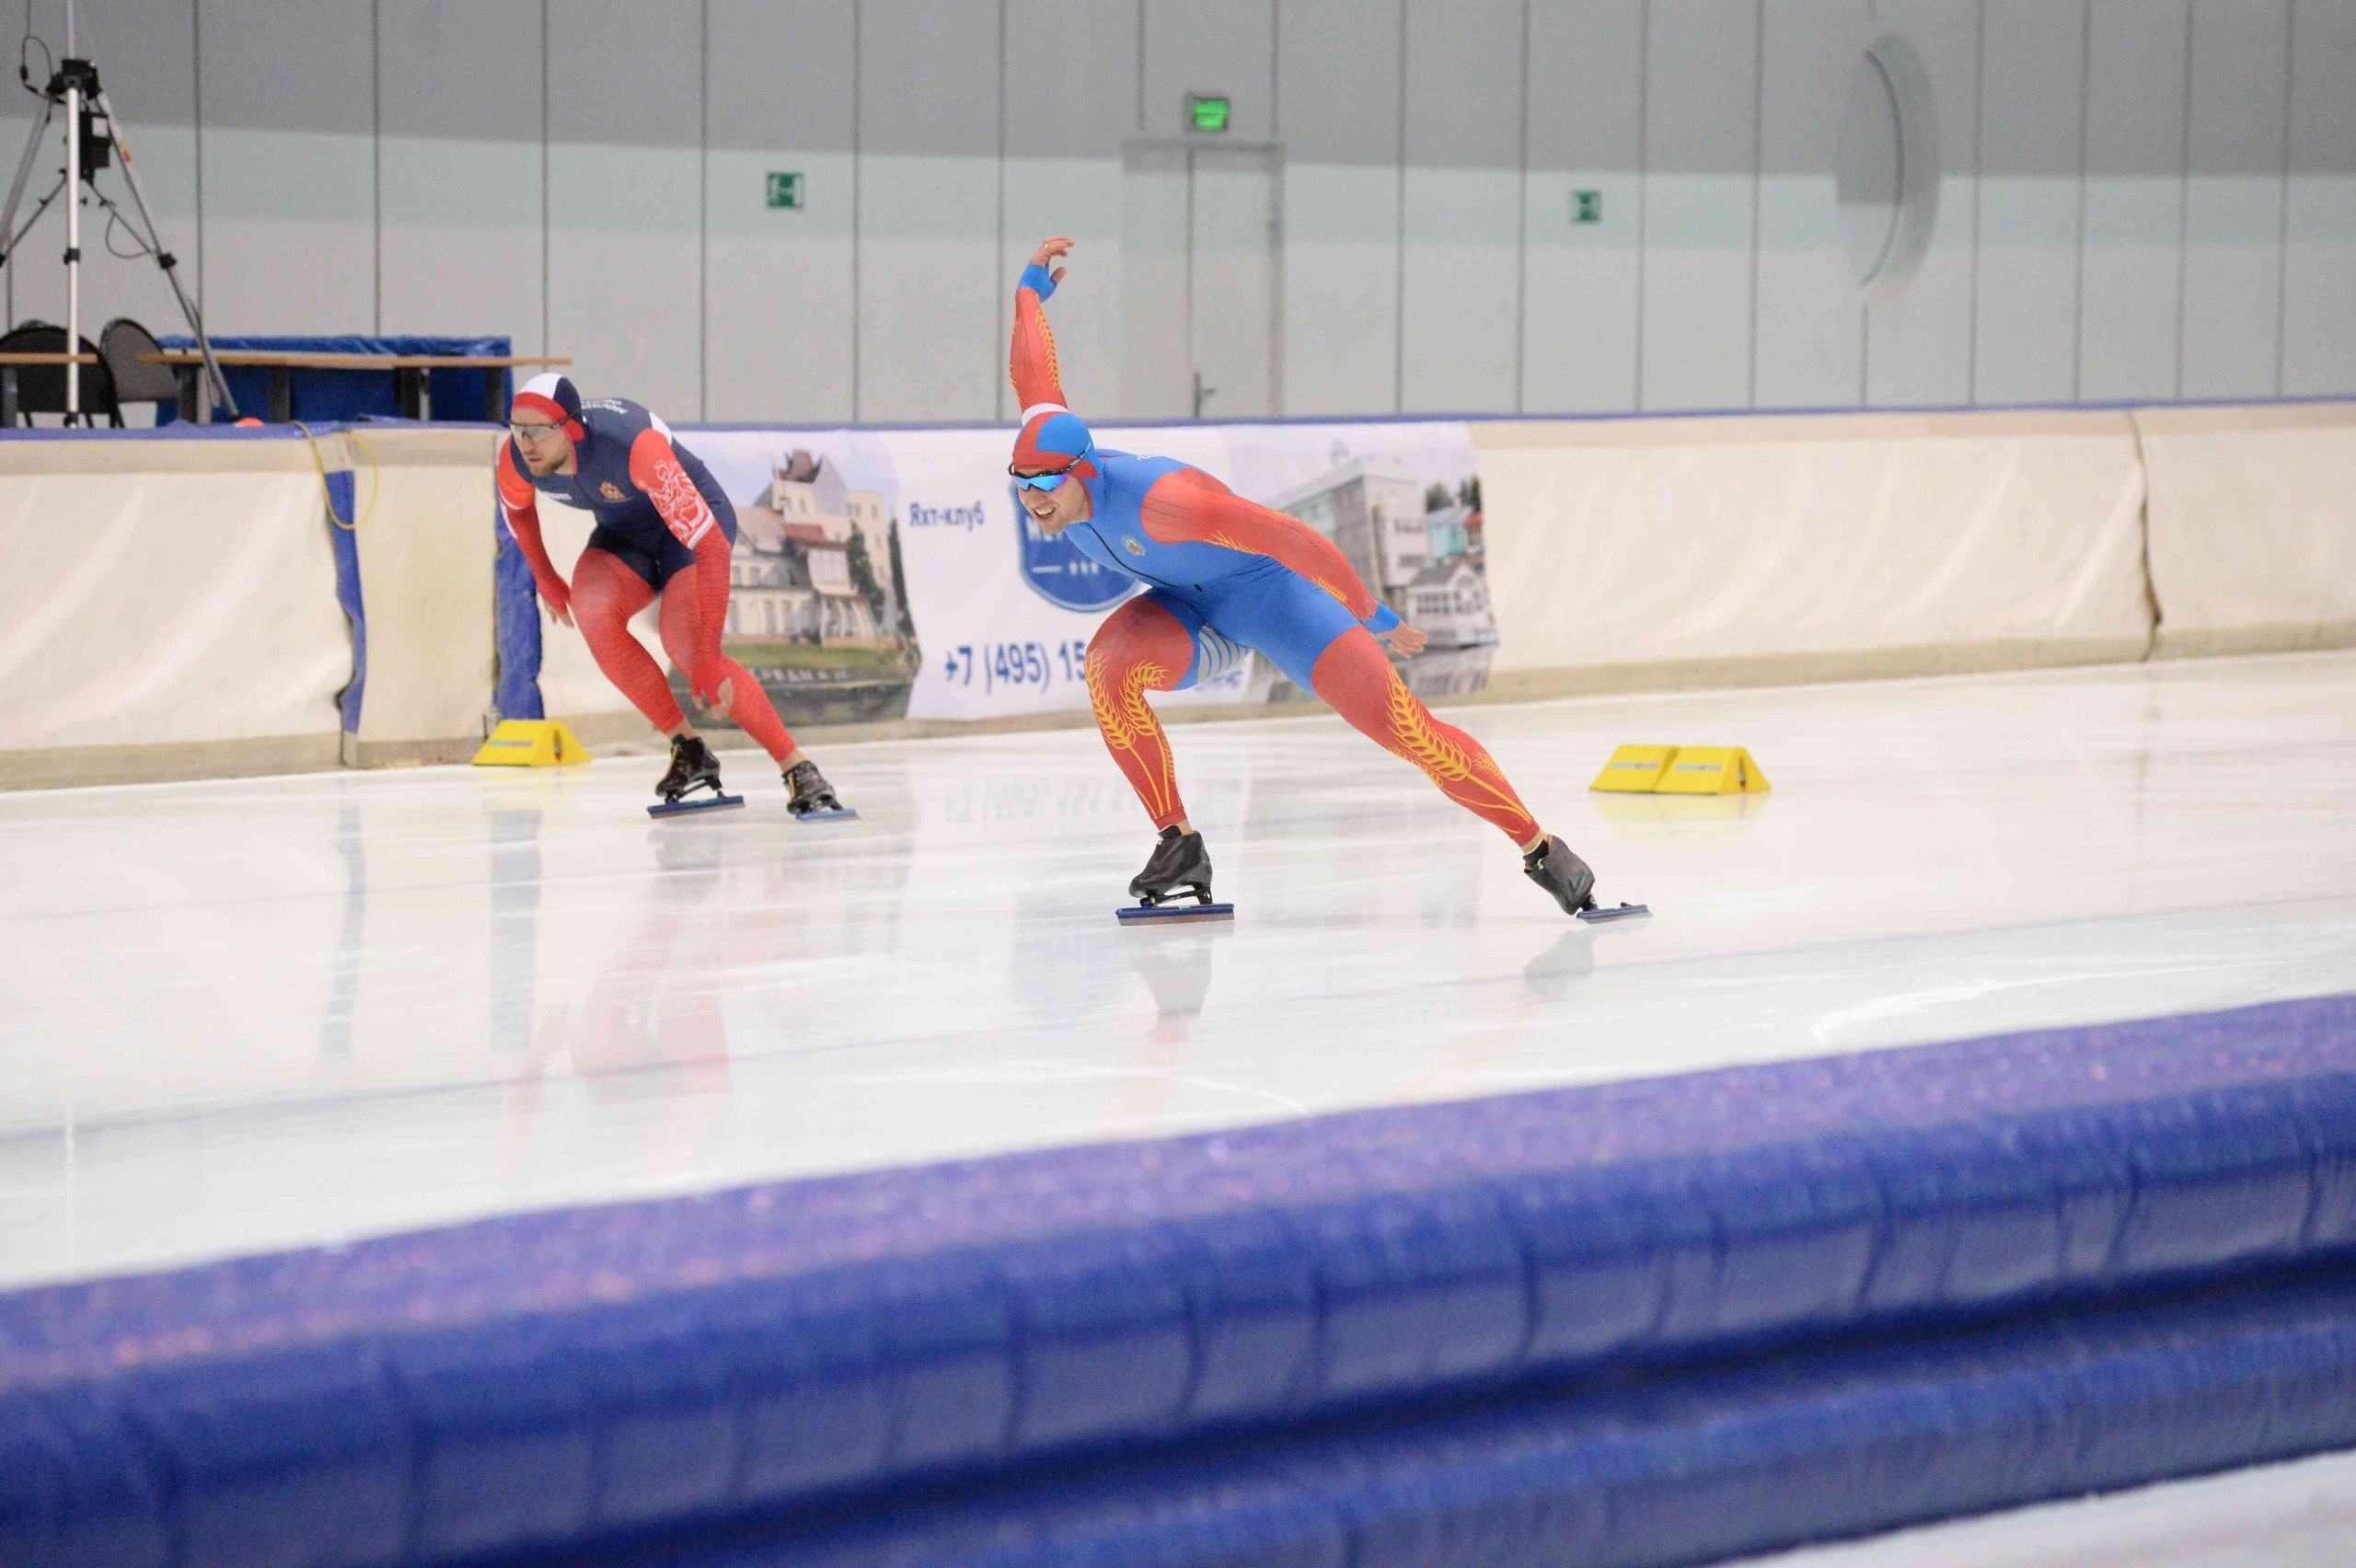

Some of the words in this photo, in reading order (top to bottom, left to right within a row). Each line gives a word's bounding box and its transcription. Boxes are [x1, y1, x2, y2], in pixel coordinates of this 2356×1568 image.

[909, 501, 985, 532] Яхт-клуб
[945, 645, 973, 686] +7
[984, 641, 1051, 696] (495)
